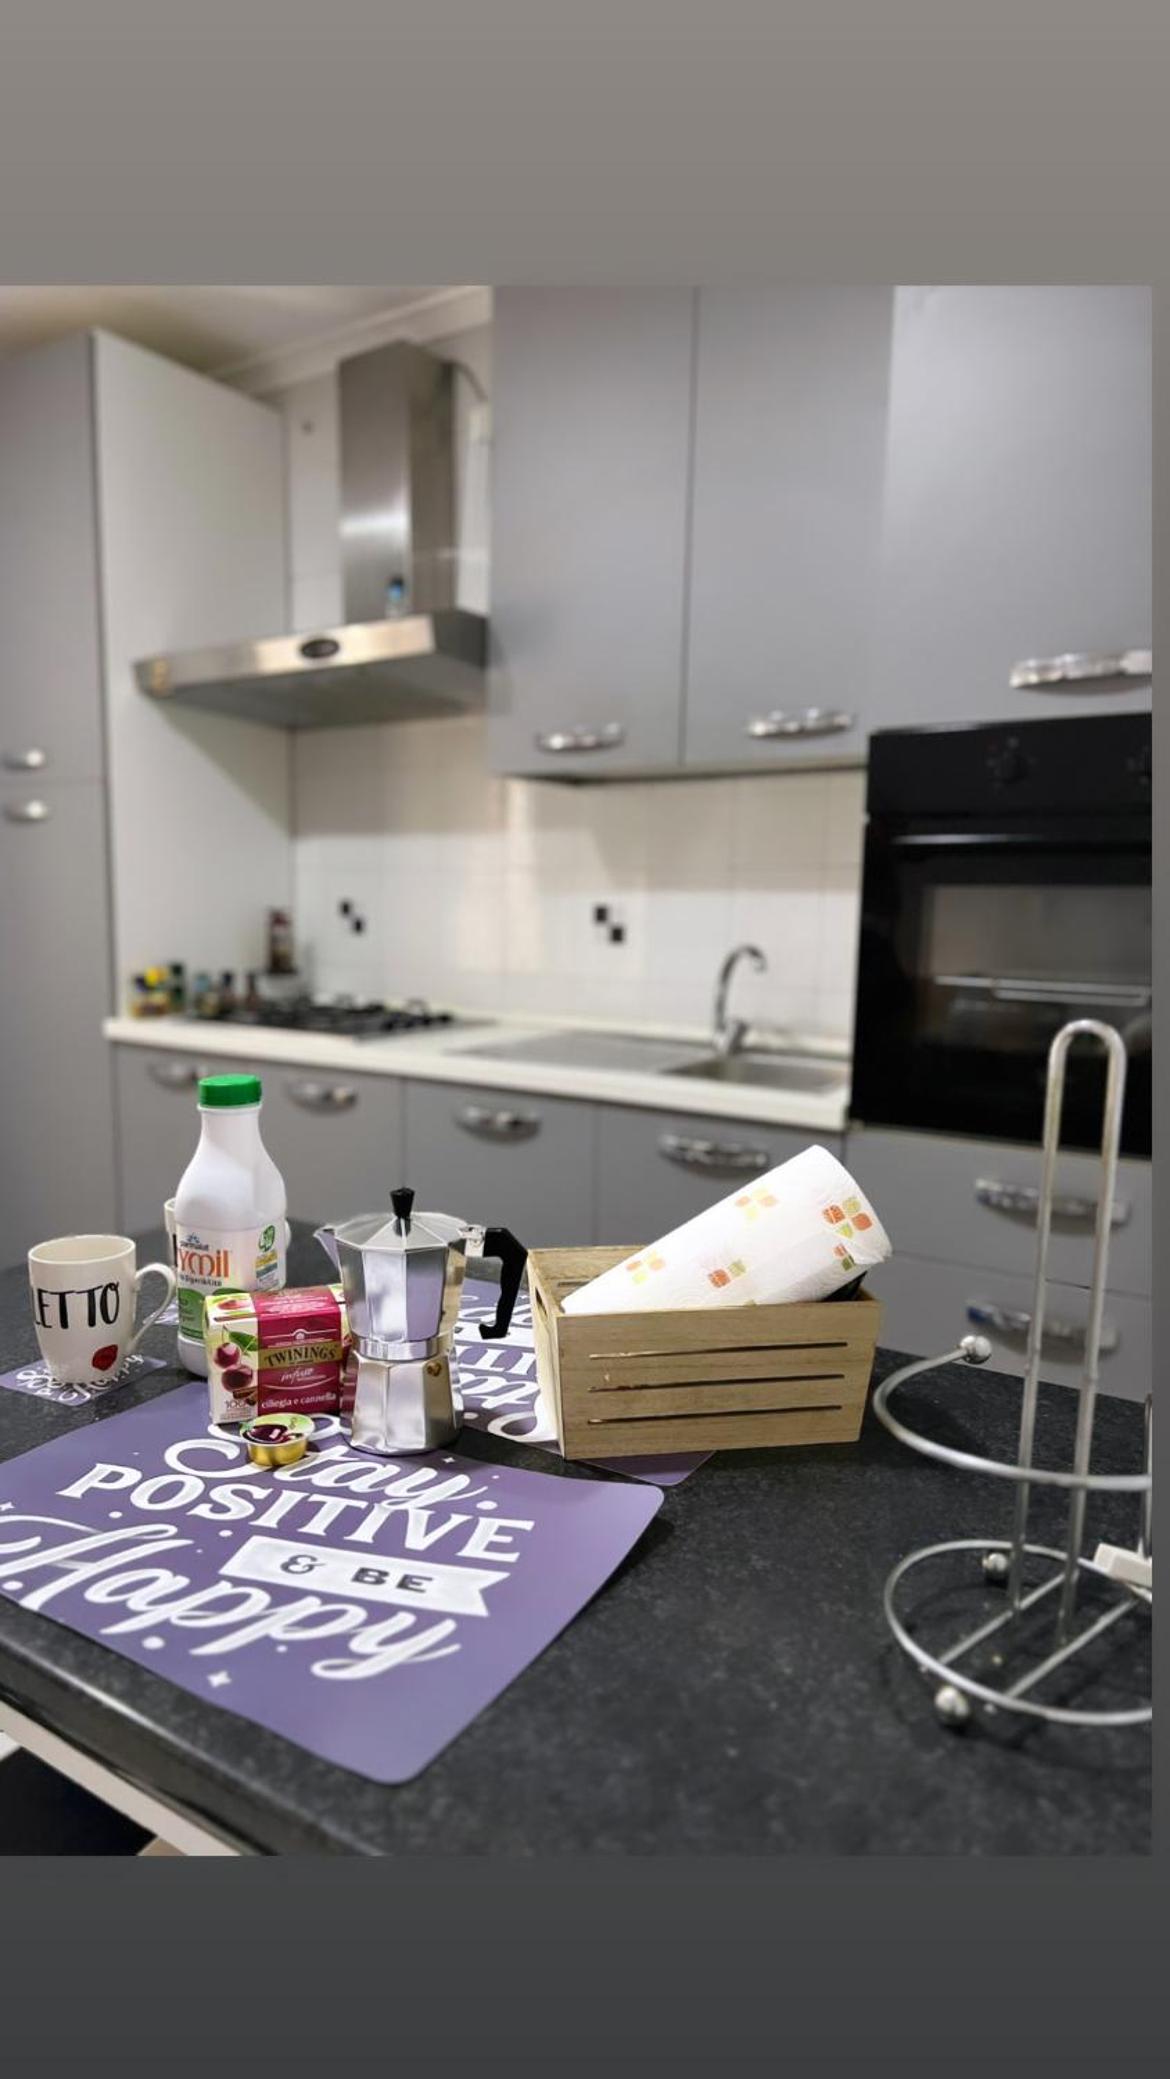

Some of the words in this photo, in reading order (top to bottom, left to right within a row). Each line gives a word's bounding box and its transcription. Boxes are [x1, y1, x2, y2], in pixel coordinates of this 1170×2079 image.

[34, 1282, 119, 1329] ETTO
[264, 1345, 337, 1367] TWININGS
[261, 1397, 292, 1409] ciliegia
[293, 1397, 299, 1405] e
[300, 1392, 337, 1405] cannella
[56, 1463, 534, 1562] POSITIVE
[280, 1554, 325, 1575] &
[351, 1567, 433, 1593] BE
[0, 1515, 461, 1679] Happy
